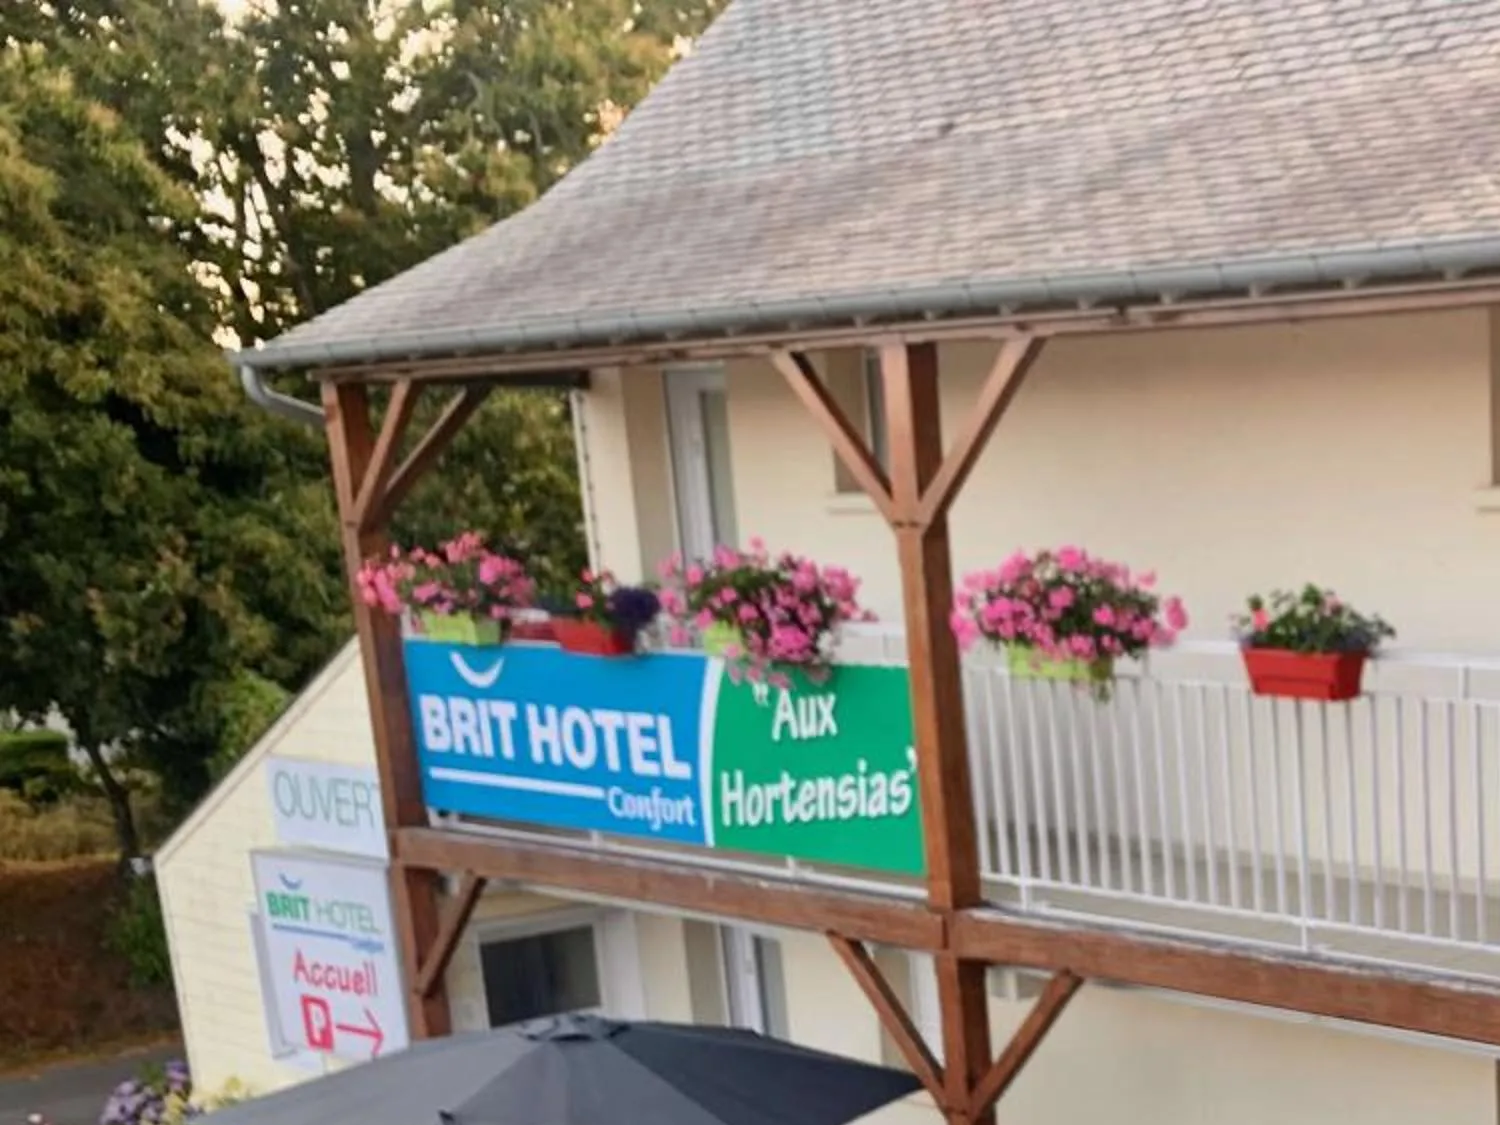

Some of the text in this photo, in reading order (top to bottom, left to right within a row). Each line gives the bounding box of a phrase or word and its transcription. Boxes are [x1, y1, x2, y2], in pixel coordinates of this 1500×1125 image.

[419, 694, 692, 780] BRIT HOTEL
[274, 770, 378, 829] OUVER
[607, 785, 696, 831] Confort
[266, 892, 383, 934] BRIT HOTEL
